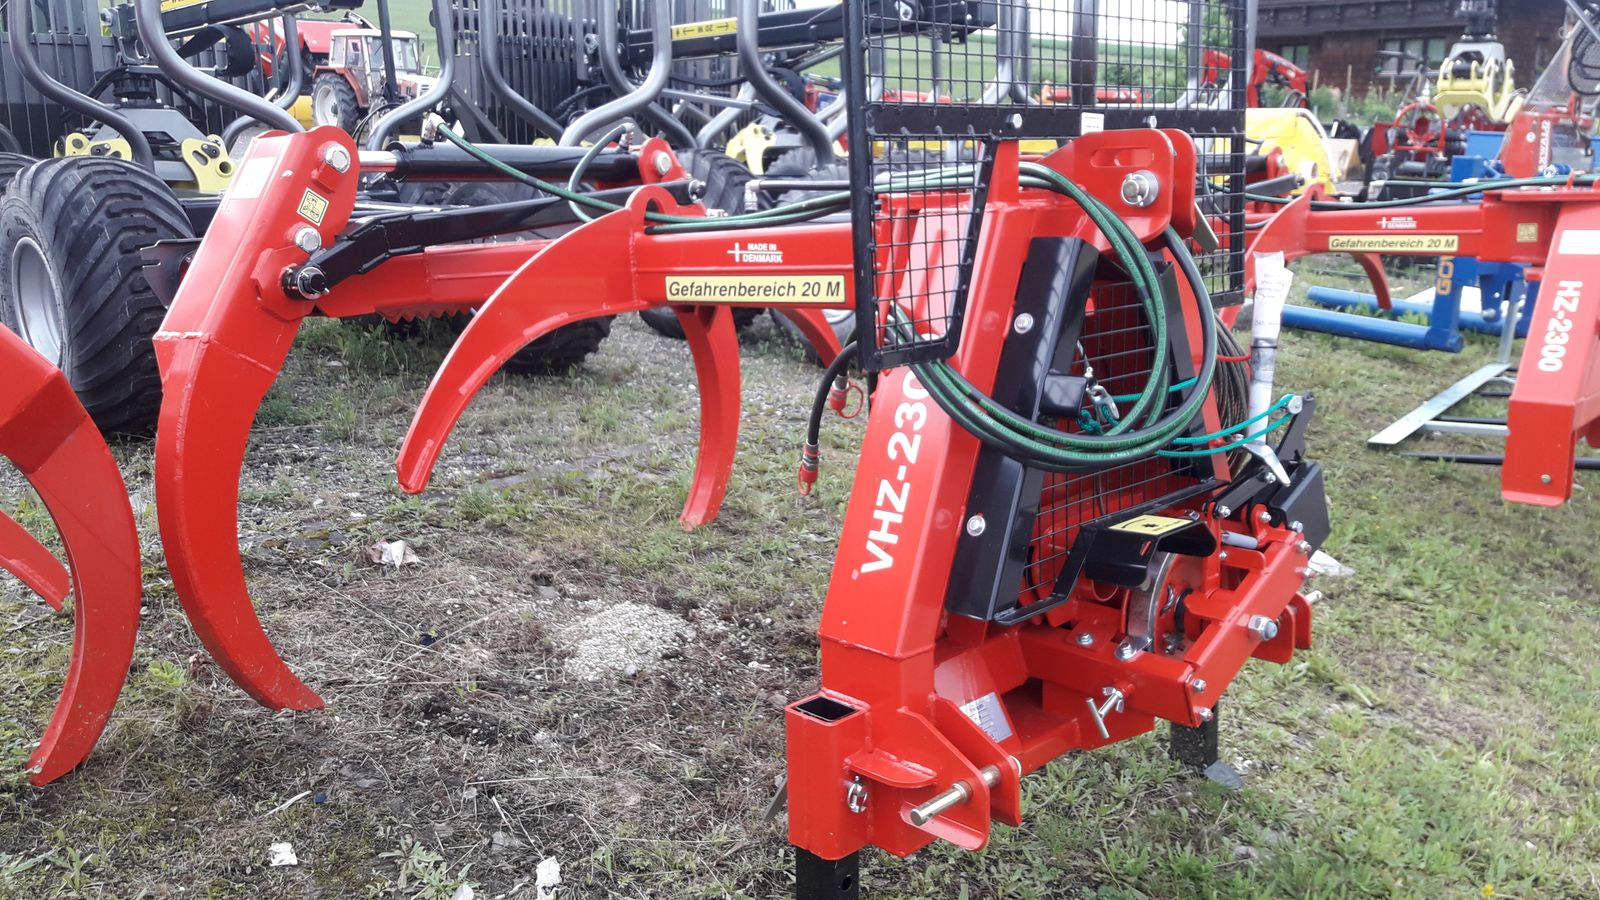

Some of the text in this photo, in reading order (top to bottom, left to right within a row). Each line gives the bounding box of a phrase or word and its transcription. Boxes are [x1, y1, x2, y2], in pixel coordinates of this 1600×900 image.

[747, 243, 777, 251] MADE IN
[1331, 238, 1455, 249] Gefahrenbereich 20 M
[742, 253, 783, 263] DENMARK
[669, 281, 841, 297] Gefahrenbereich 20 M
[1537, 280, 1583, 372] HZ-2300
[860, 333, 943, 573] VHZ-230
